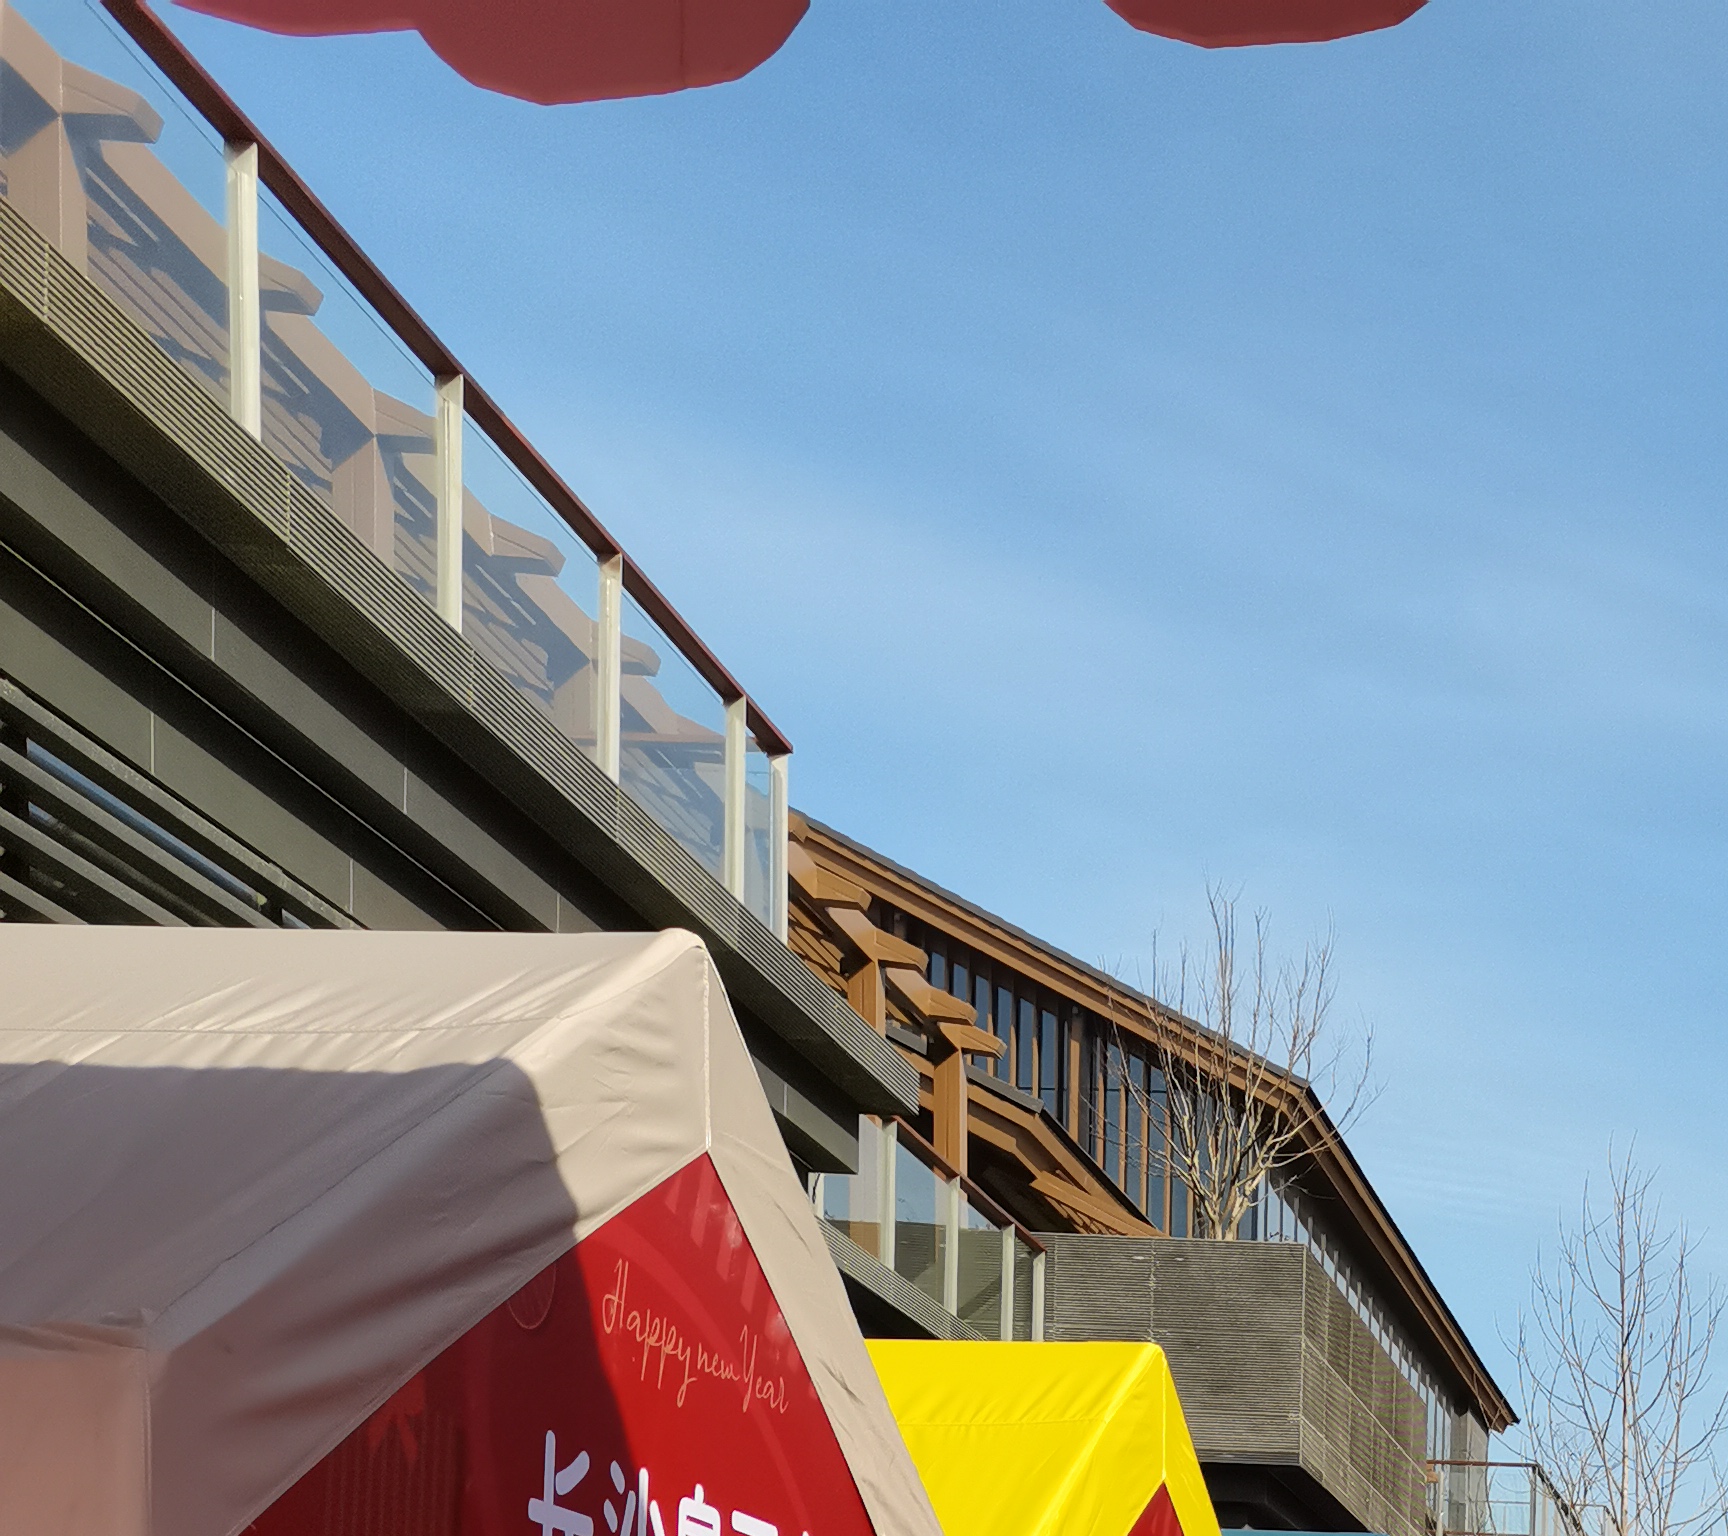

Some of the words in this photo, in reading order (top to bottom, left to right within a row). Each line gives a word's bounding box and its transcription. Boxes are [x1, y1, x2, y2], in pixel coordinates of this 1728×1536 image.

[602, 1258, 698, 1409] Happy
[697, 1342, 740, 1381] new
[740, 1324, 790, 1414] Year
